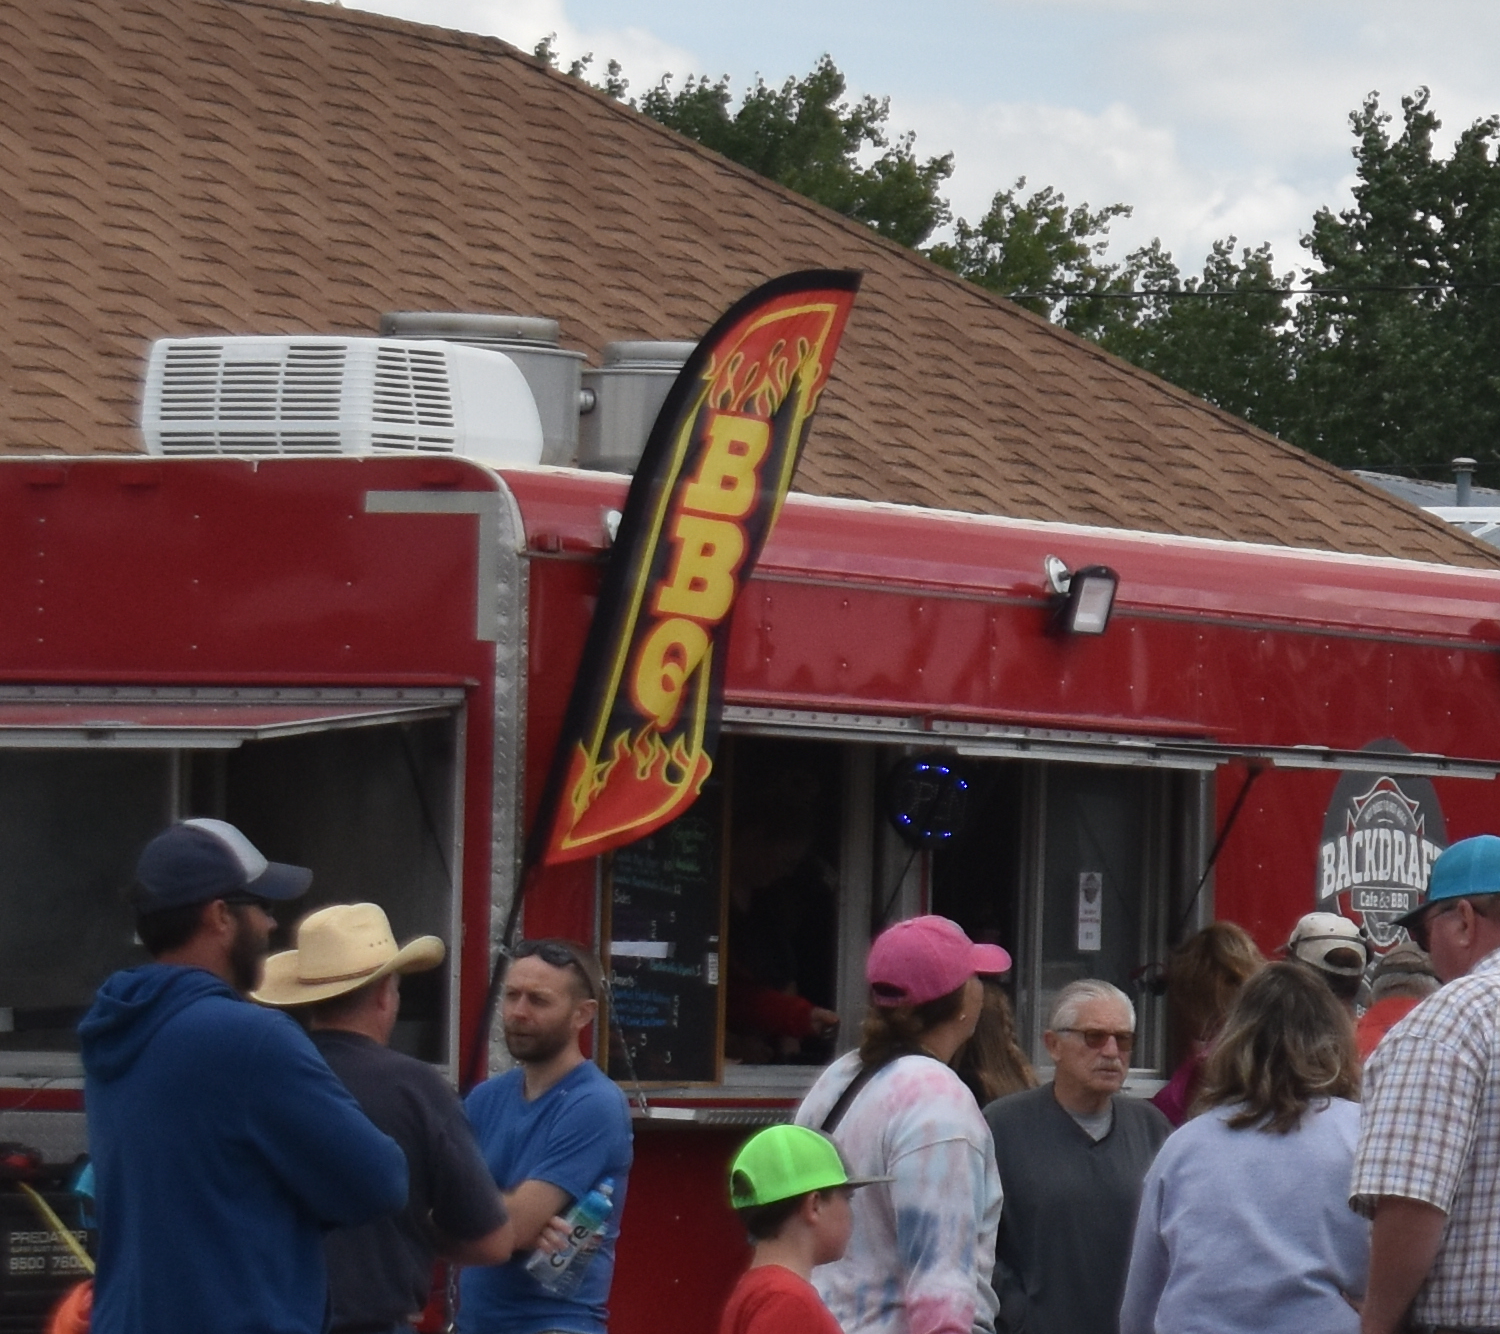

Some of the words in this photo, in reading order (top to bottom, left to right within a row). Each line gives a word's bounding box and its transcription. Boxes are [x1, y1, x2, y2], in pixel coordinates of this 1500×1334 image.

[633, 413, 772, 730] BBQ
[1321, 828, 1443, 900] BACKDRAF
[1360, 891, 1379, 908] Cafe
[1391, 892, 1409, 911] BBQ
